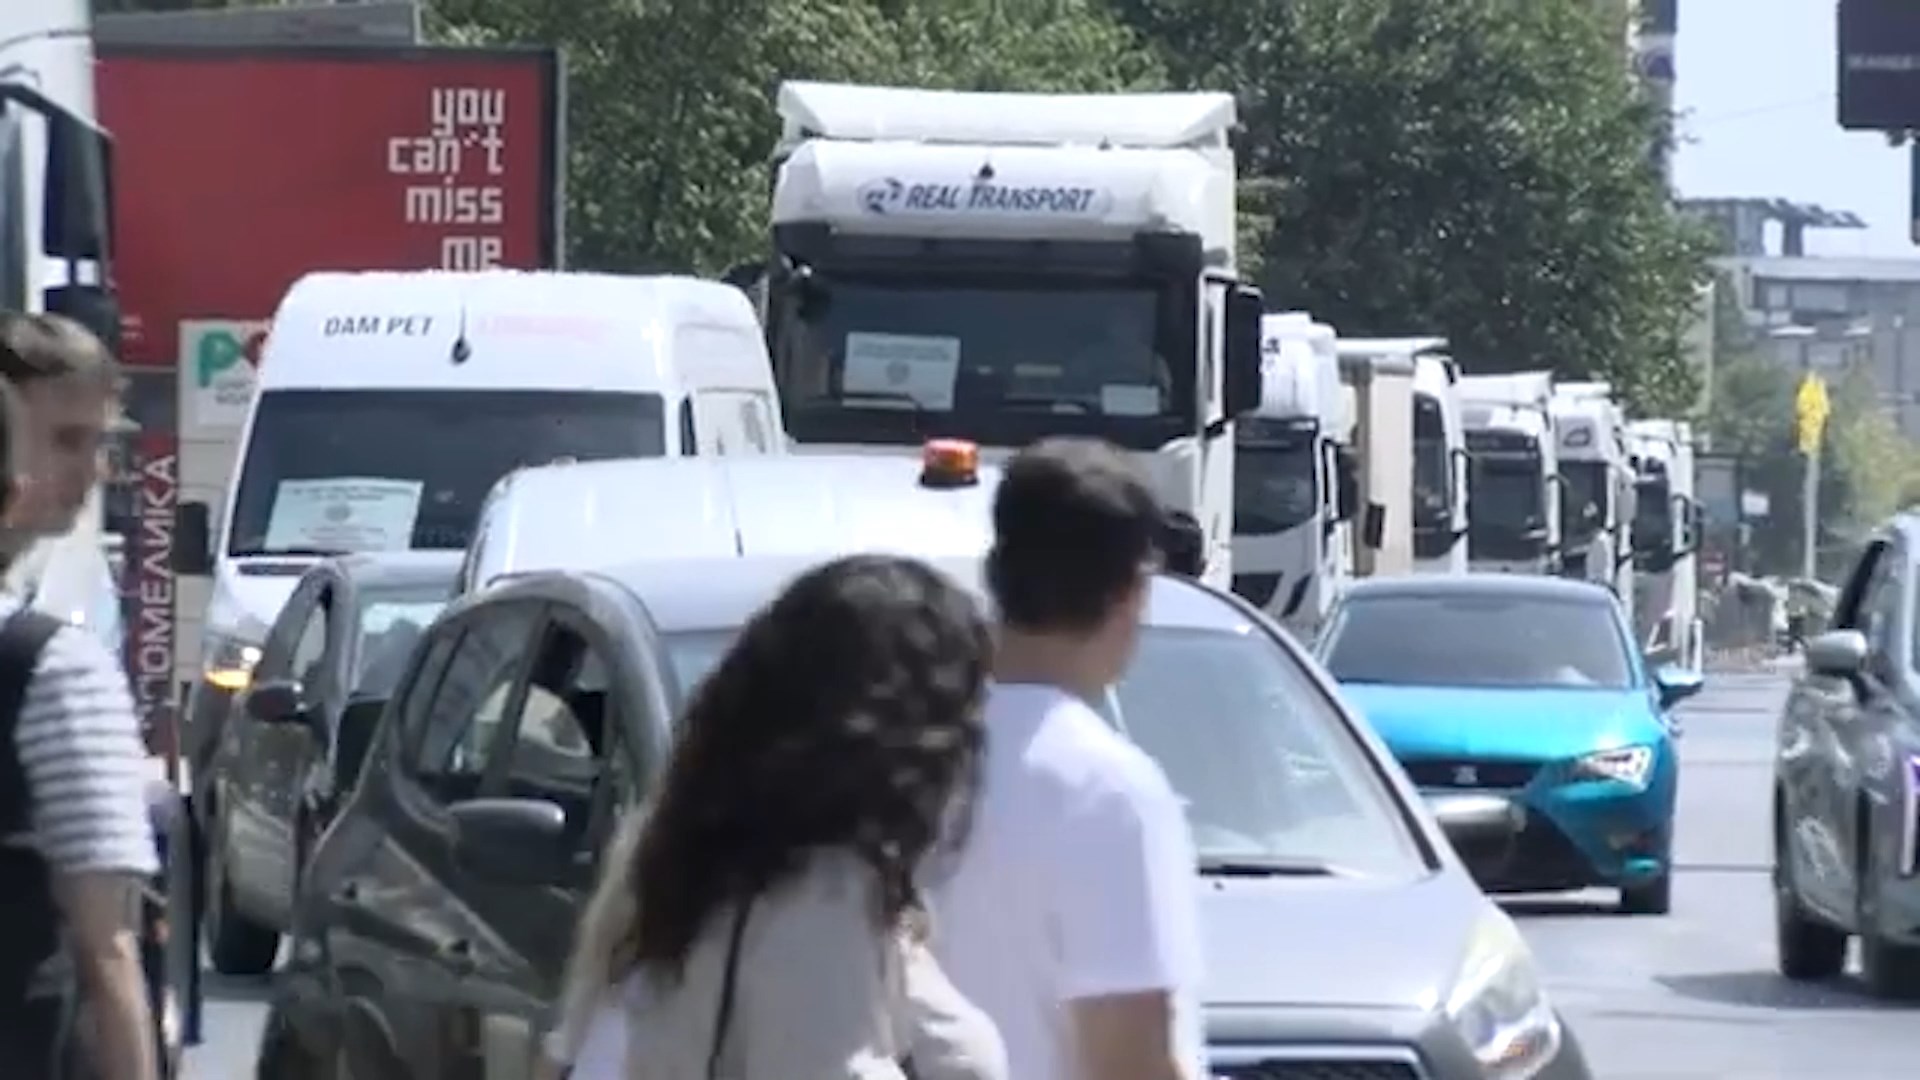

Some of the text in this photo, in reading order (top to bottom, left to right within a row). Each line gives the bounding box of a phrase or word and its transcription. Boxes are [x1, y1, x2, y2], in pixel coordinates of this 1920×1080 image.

[431, 87, 504, 137] you
[388, 125, 504, 174] can't
[406, 176, 503, 223] miss
[906, 184, 1095, 212] REAL TRANSPORT
[442, 236, 502, 272] me
[324, 315, 432, 336] DAM PET
